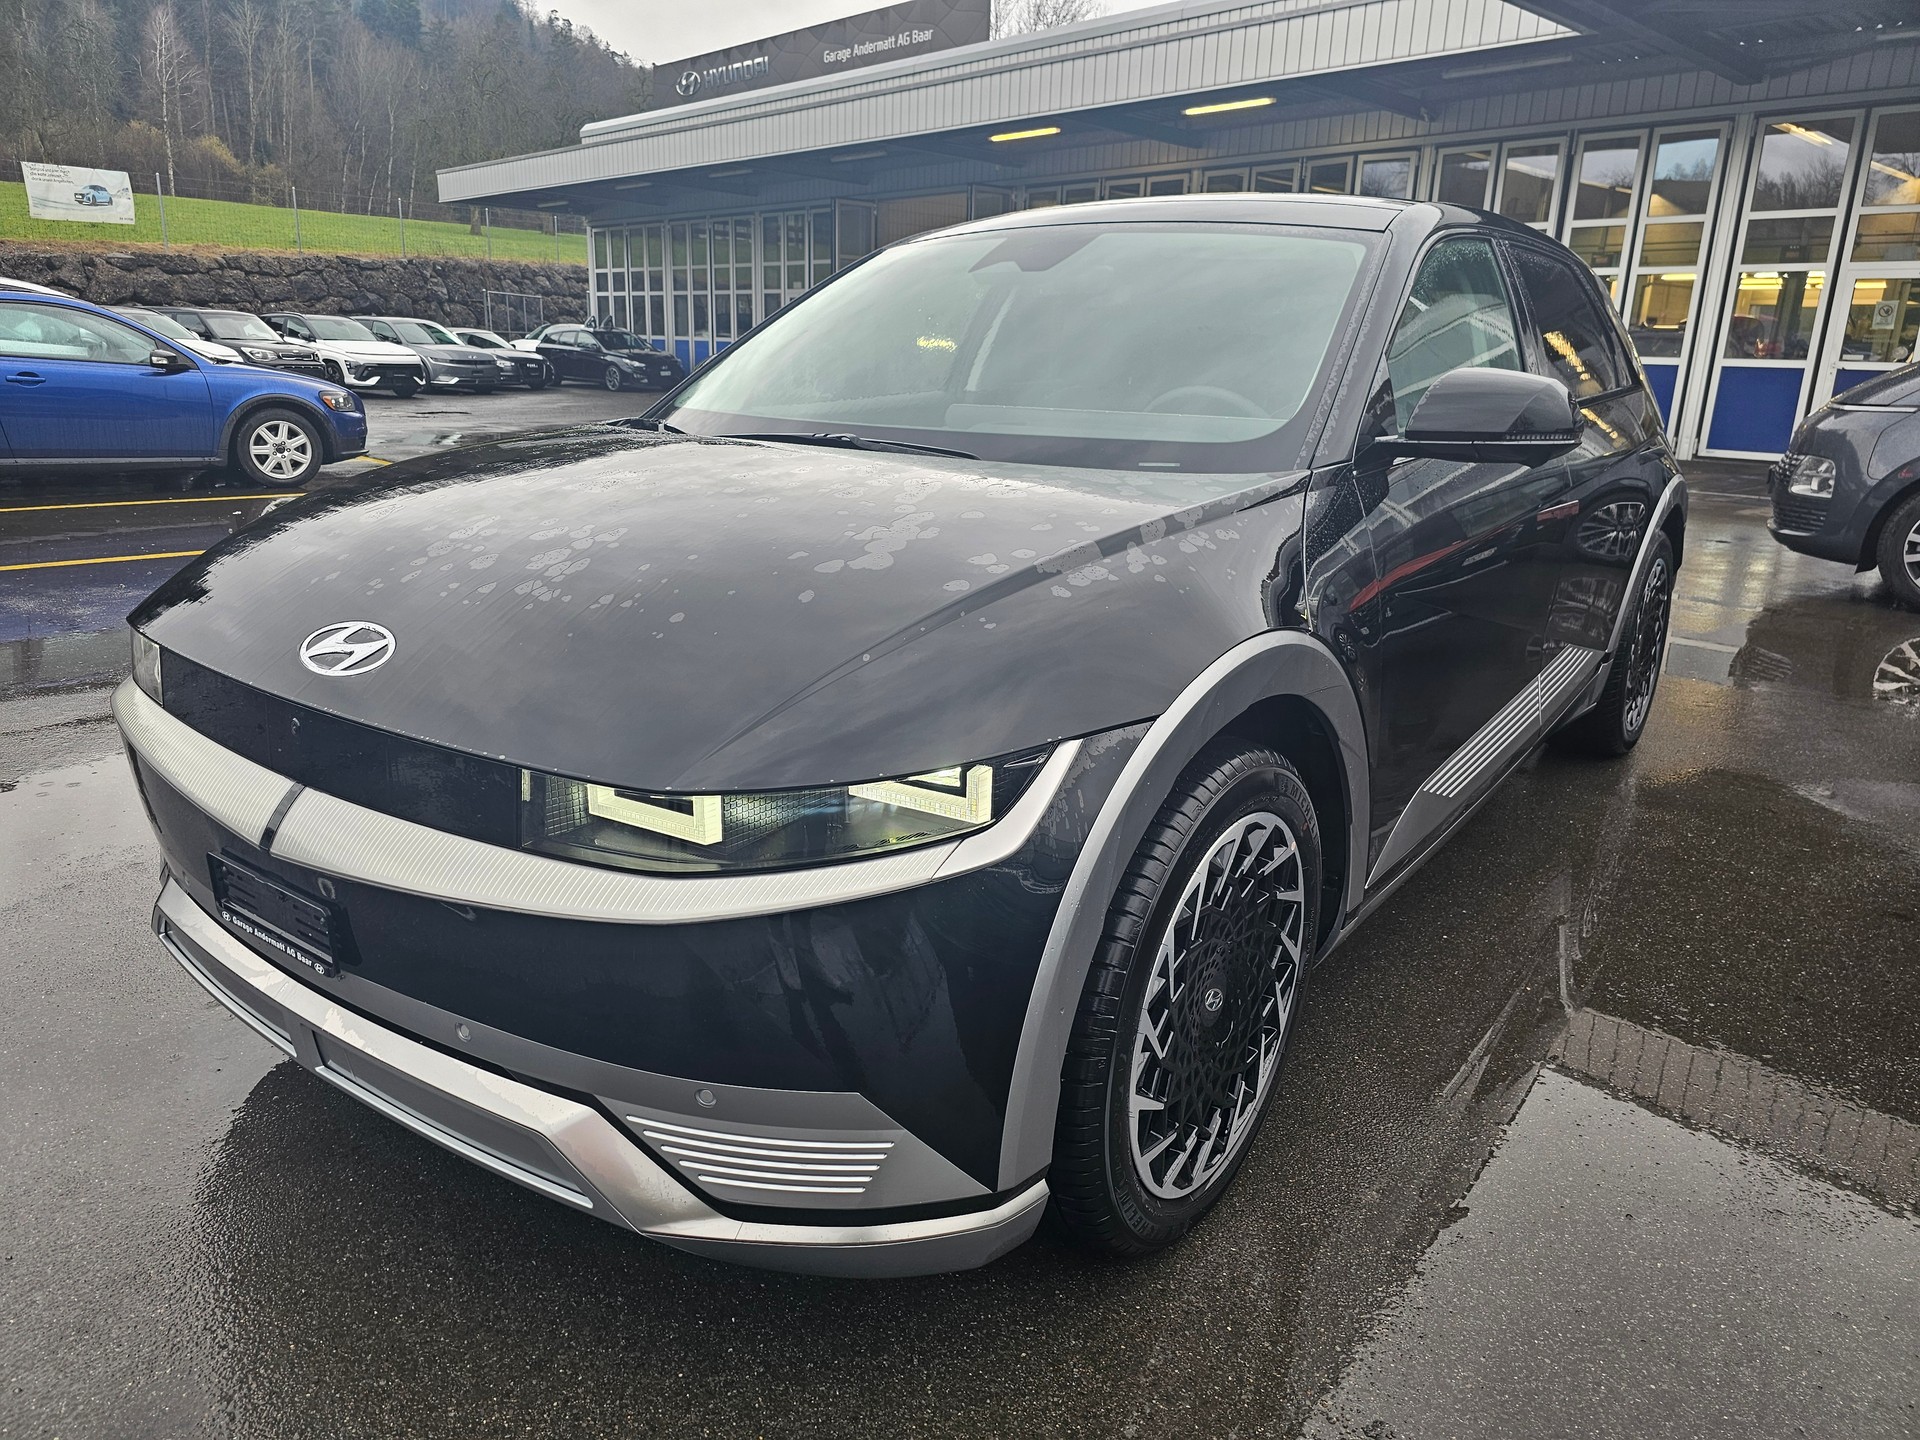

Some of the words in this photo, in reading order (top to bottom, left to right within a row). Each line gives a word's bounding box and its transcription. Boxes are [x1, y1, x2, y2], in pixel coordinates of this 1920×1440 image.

[823, 48, 852, 63] Garage
[852, 35, 896, 57] Andermatt
[897, 31, 910, 47] AG
[911, 29, 935, 44] Baar
[703, 56, 769, 88] HYUNDAI
[232, 915, 253, 933] Garage
[254, 928, 286, 952] Andermatt
[286, 946, 296, 958] AG
[296, 952, 313, 967] Baar
